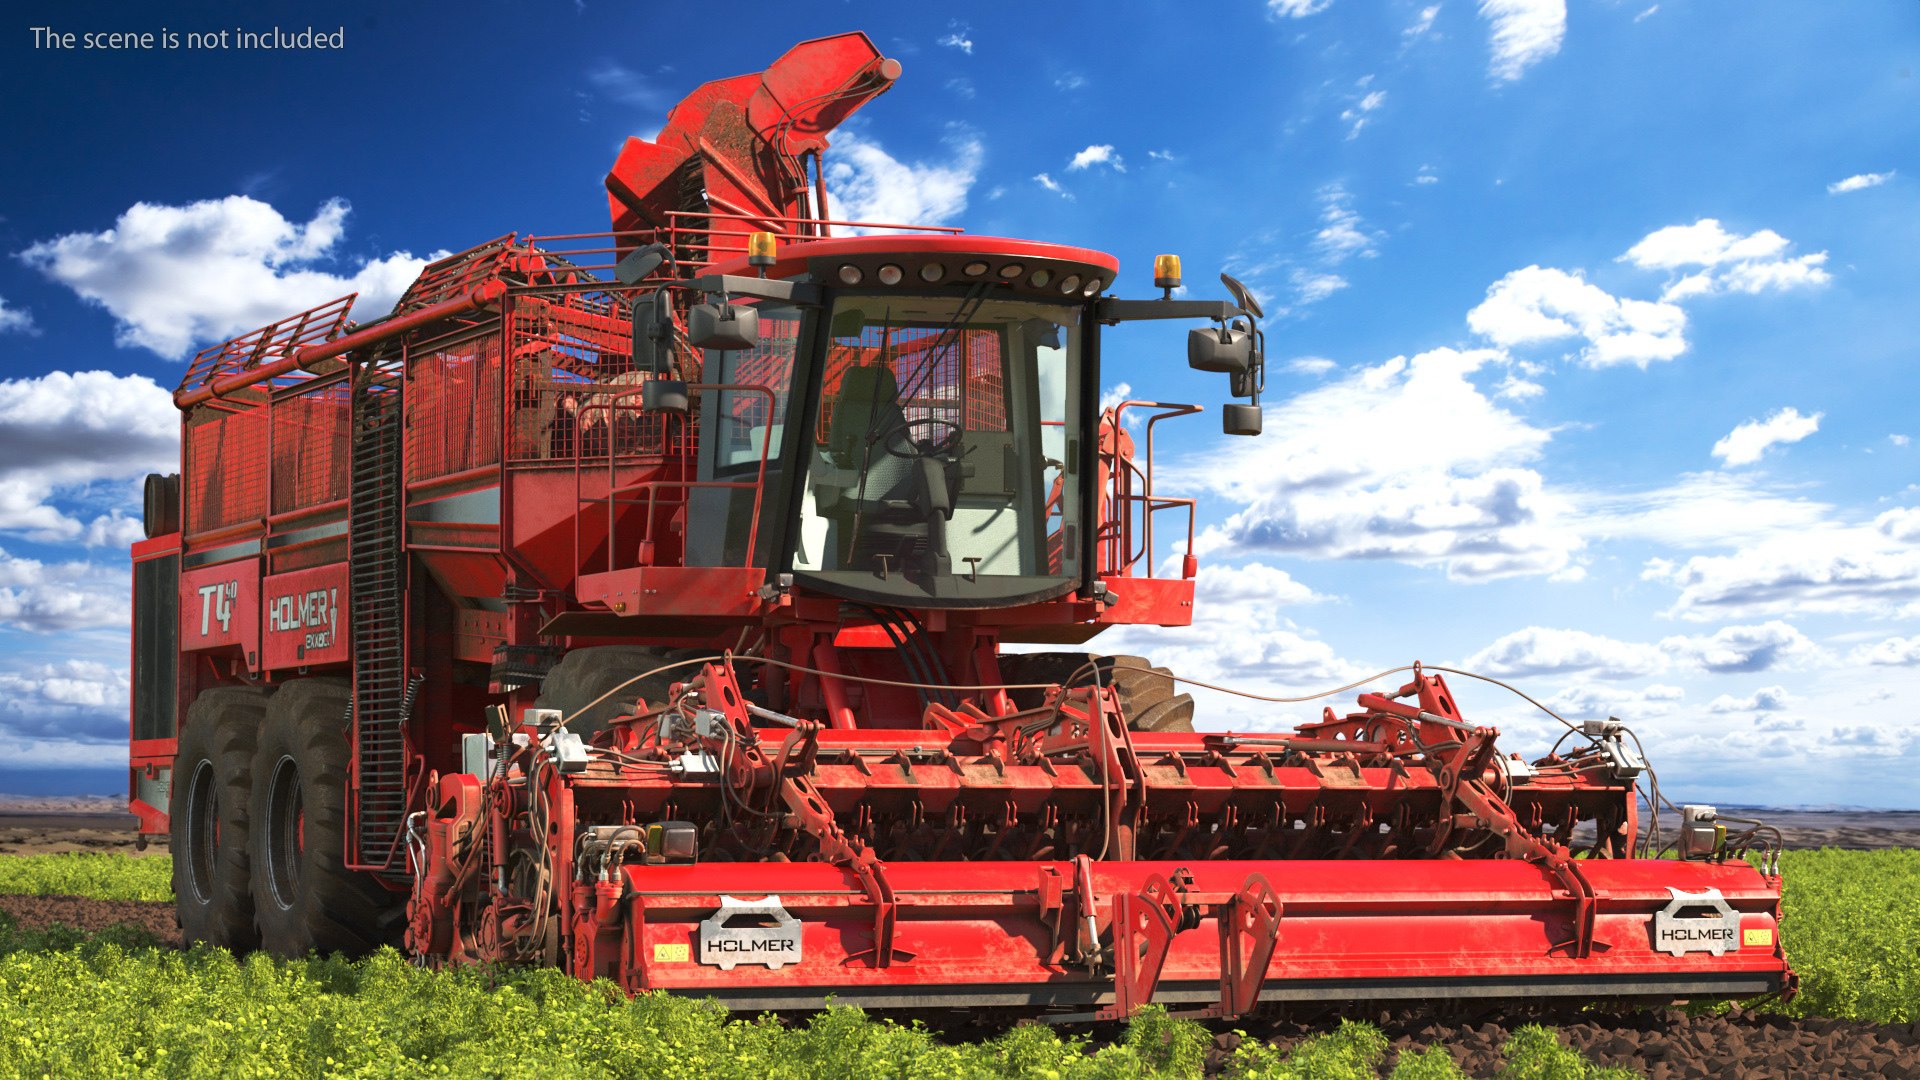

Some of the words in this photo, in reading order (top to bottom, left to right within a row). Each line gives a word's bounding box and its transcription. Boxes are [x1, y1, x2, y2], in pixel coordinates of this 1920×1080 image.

[269, 589, 328, 632] HOLMER
[1661, 928, 1734, 941] HOLMER
[707, 939, 794, 953] HOLMER
